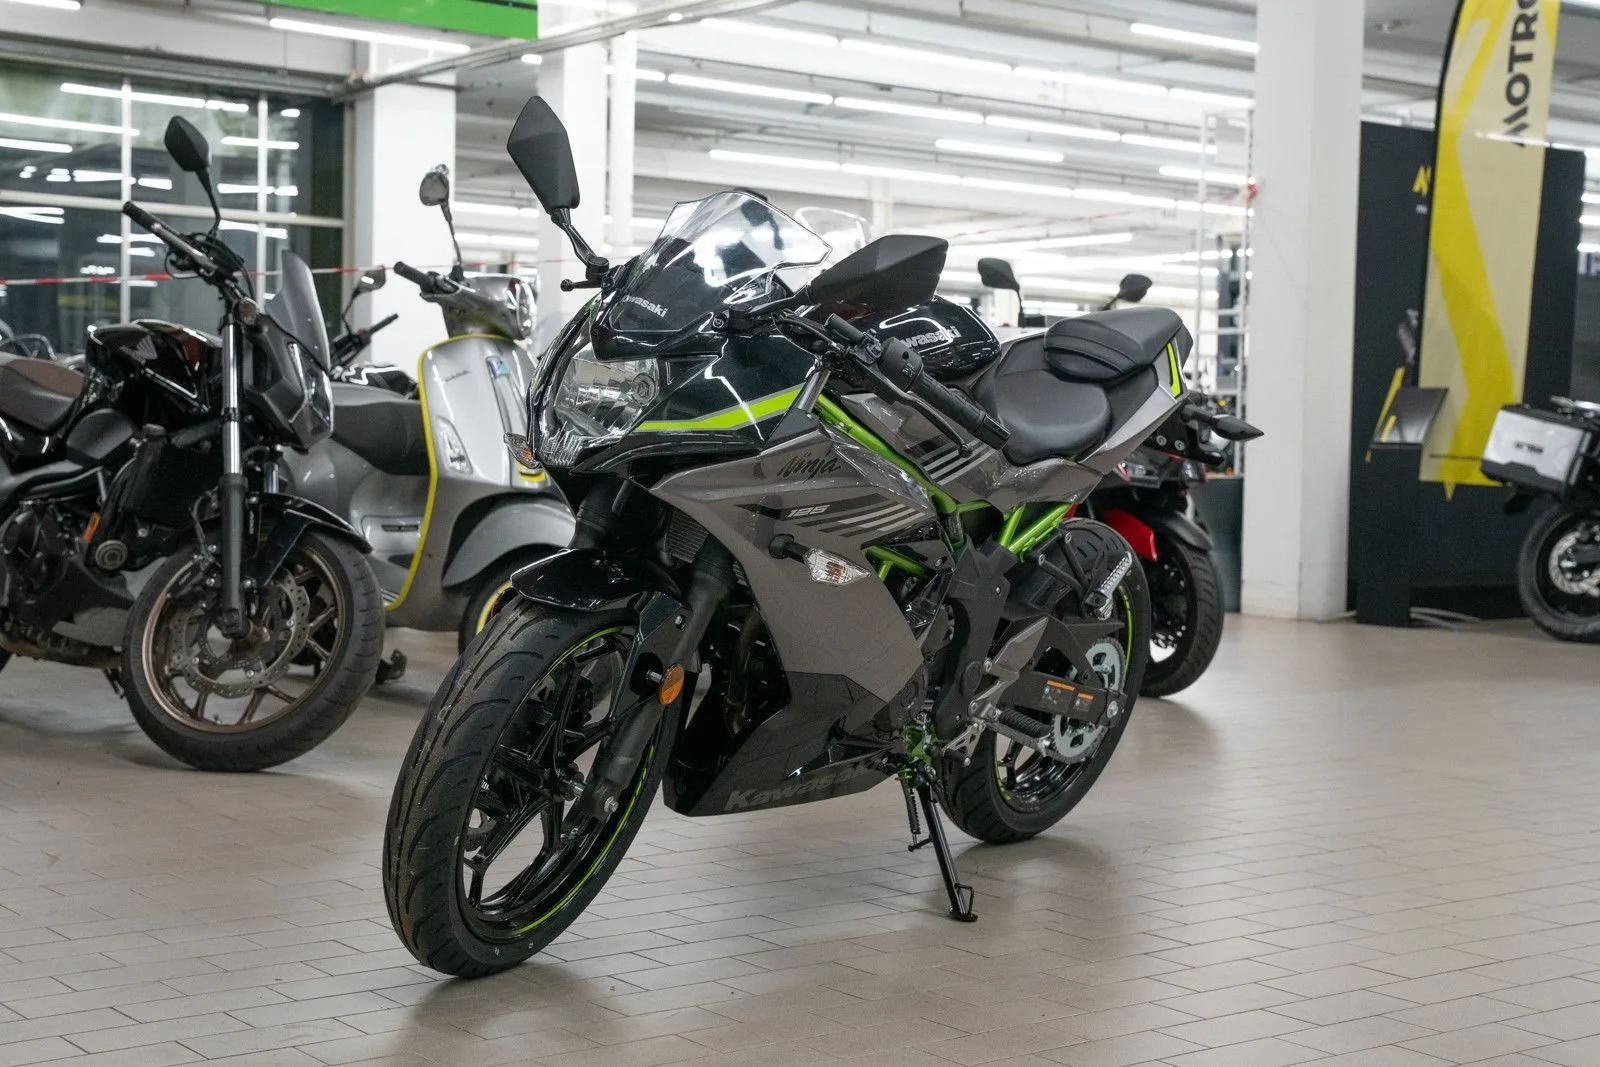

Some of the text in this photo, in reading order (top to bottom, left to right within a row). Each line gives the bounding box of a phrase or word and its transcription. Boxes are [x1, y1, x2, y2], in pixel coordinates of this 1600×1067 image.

[899, 325, 961, 348] wasaki
[777, 449, 841, 484] Ninja
[787, 504, 831, 518] 125
